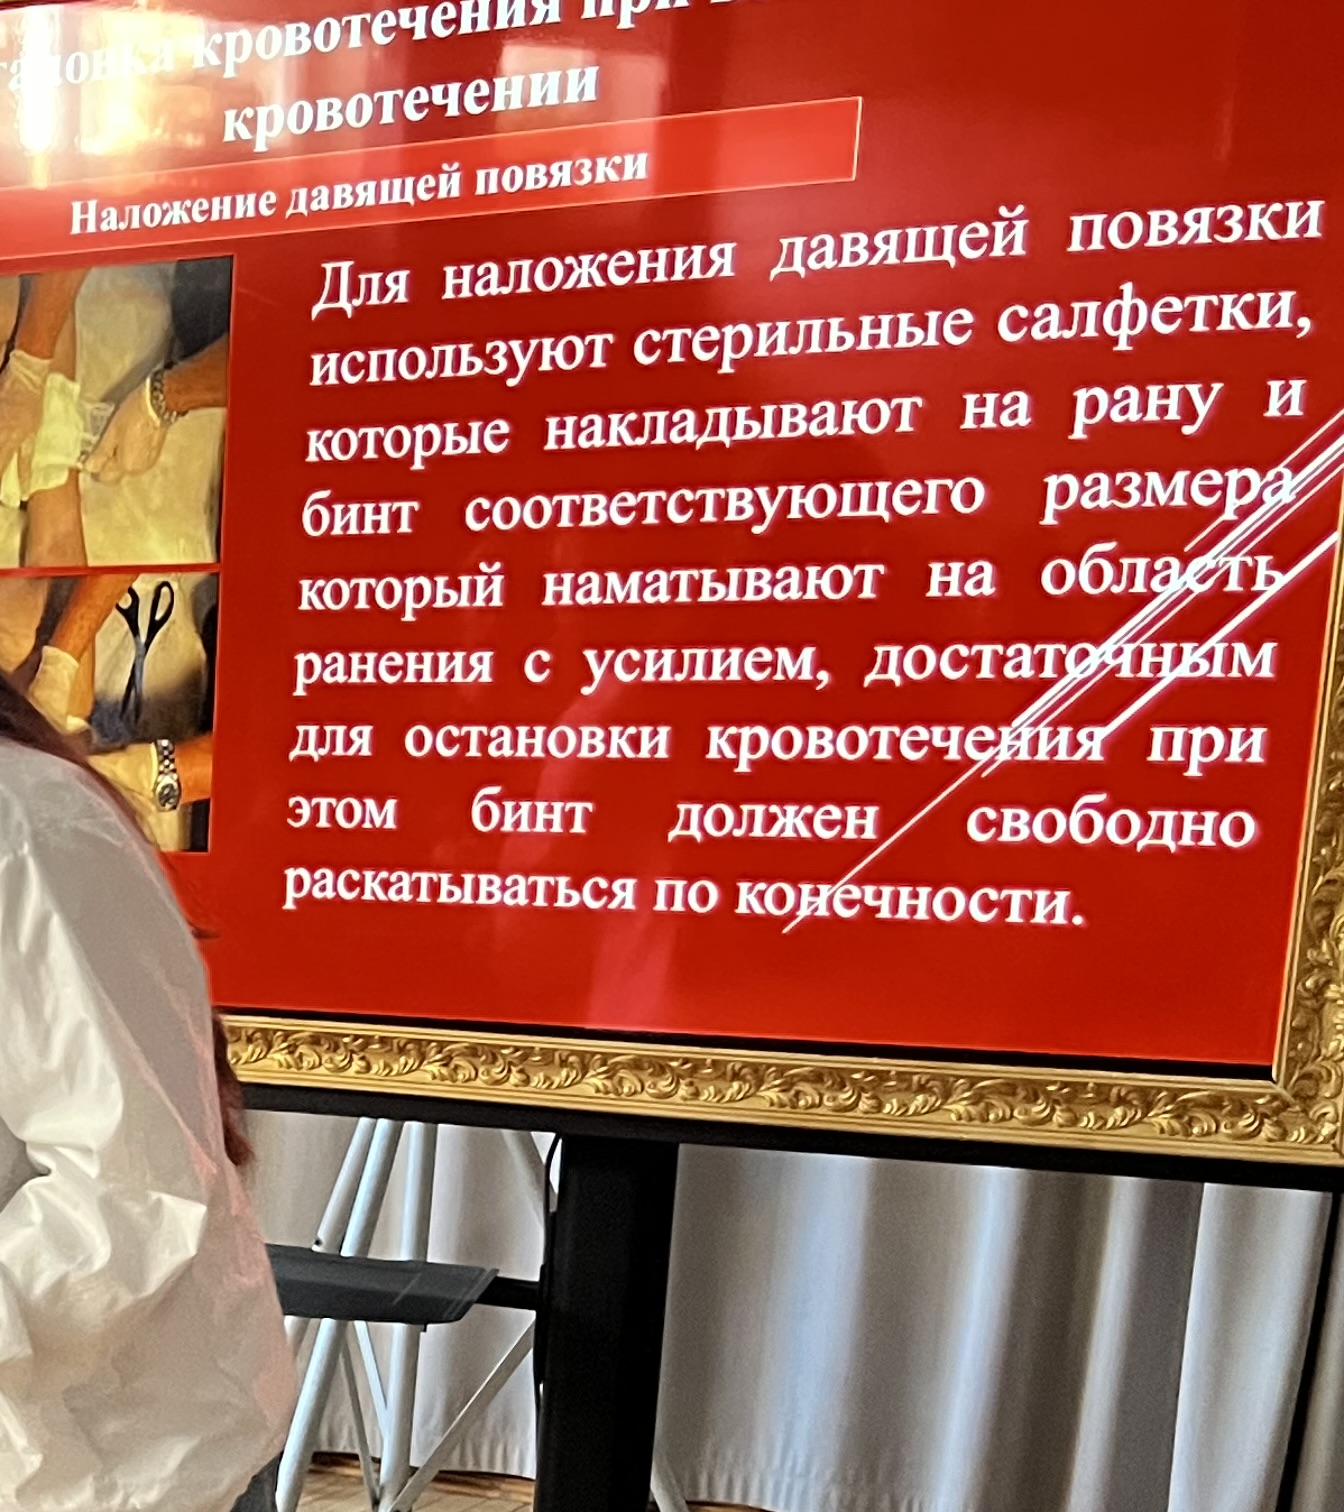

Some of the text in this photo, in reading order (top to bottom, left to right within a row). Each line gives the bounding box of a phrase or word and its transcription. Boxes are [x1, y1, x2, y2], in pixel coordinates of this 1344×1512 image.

[192, 0, 561, 78] кровотечения
[223, 65, 599, 152] кровотечении
[69, 152, 649, 235] Наложение давящей повязки
[312, 201, 1325, 320] Для наложения давящей повязки
[310, 282, 1311, 386] используют стерильные салфетки,
[306, 380, 1306, 470] которые накладывают на рану и
[303, 462, 1297, 536] бинт соответствующего размера
[299, 539, 1287, 621] который наматывают на область
[293, 637, 1276, 696] ранения с усилием, достаточным
[289, 722, 1267, 776] для остановки кровотечения при
[287, 786, 1256, 853] этом бинт должен свободно
[283, 868, 1083, 927] раскатываться по конечности.
